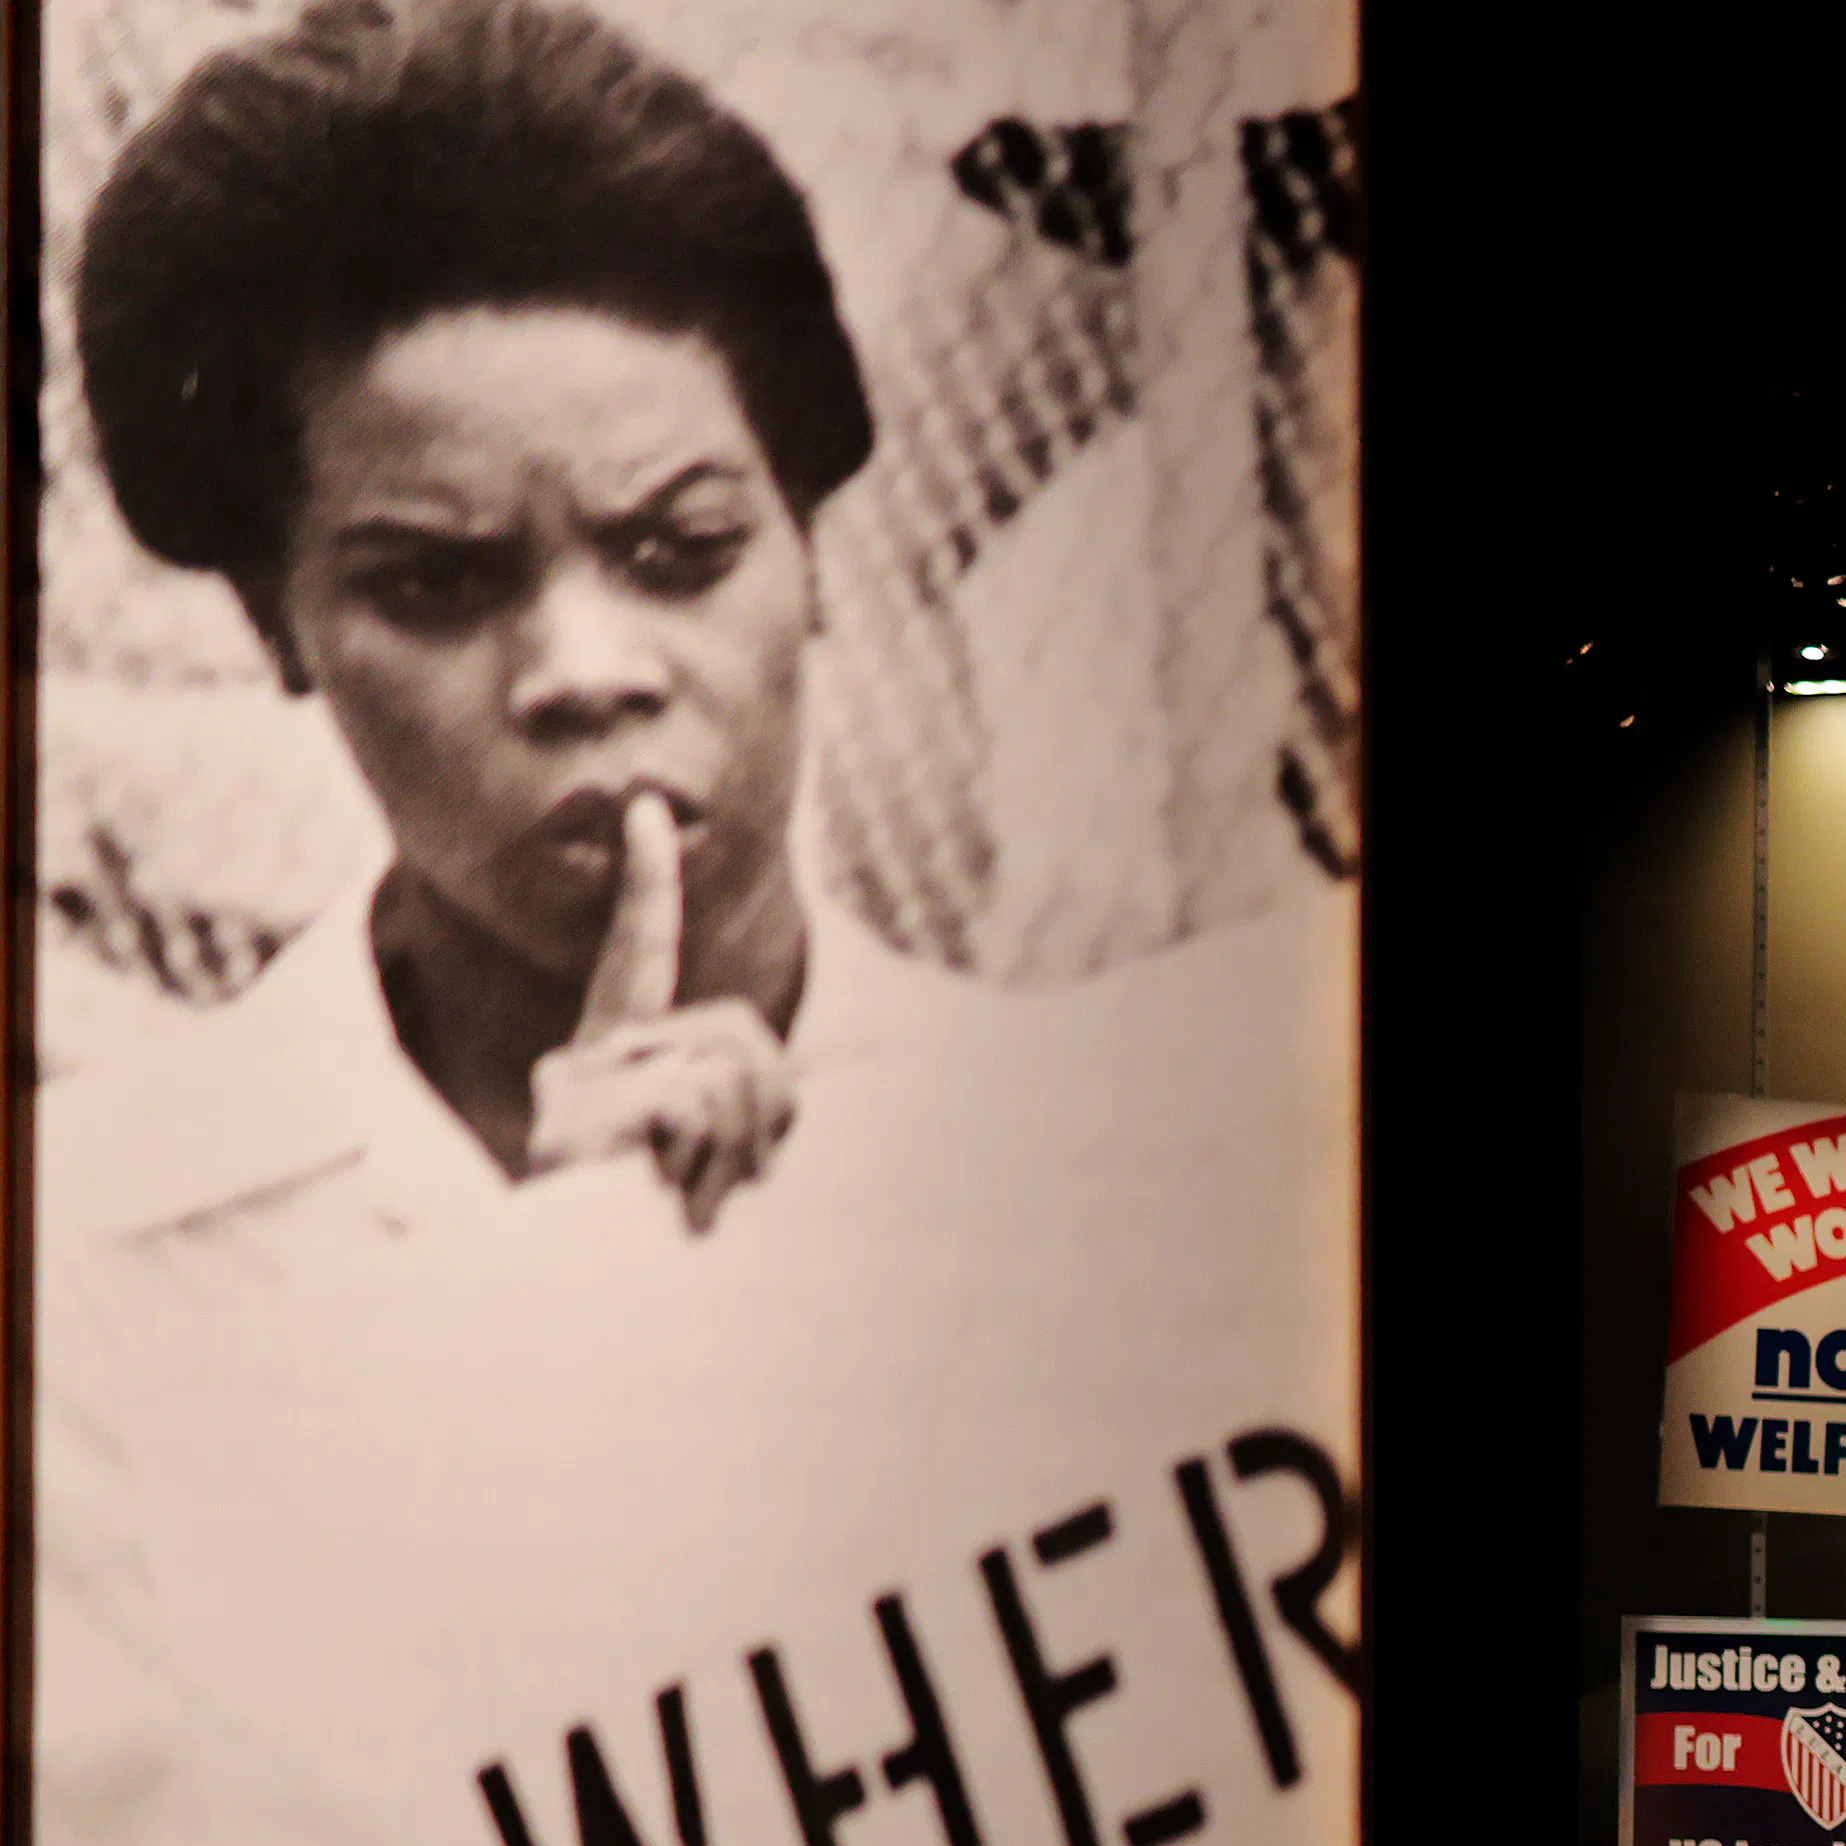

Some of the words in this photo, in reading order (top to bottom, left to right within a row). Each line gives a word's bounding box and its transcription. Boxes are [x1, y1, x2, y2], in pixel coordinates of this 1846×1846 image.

[1689, 1153, 1796, 1234] WE
[1651, 1646, 1806, 1692] Justice
[1816, 1654, 1846, 1692] &
[1674, 1726, 1741, 1771] For
